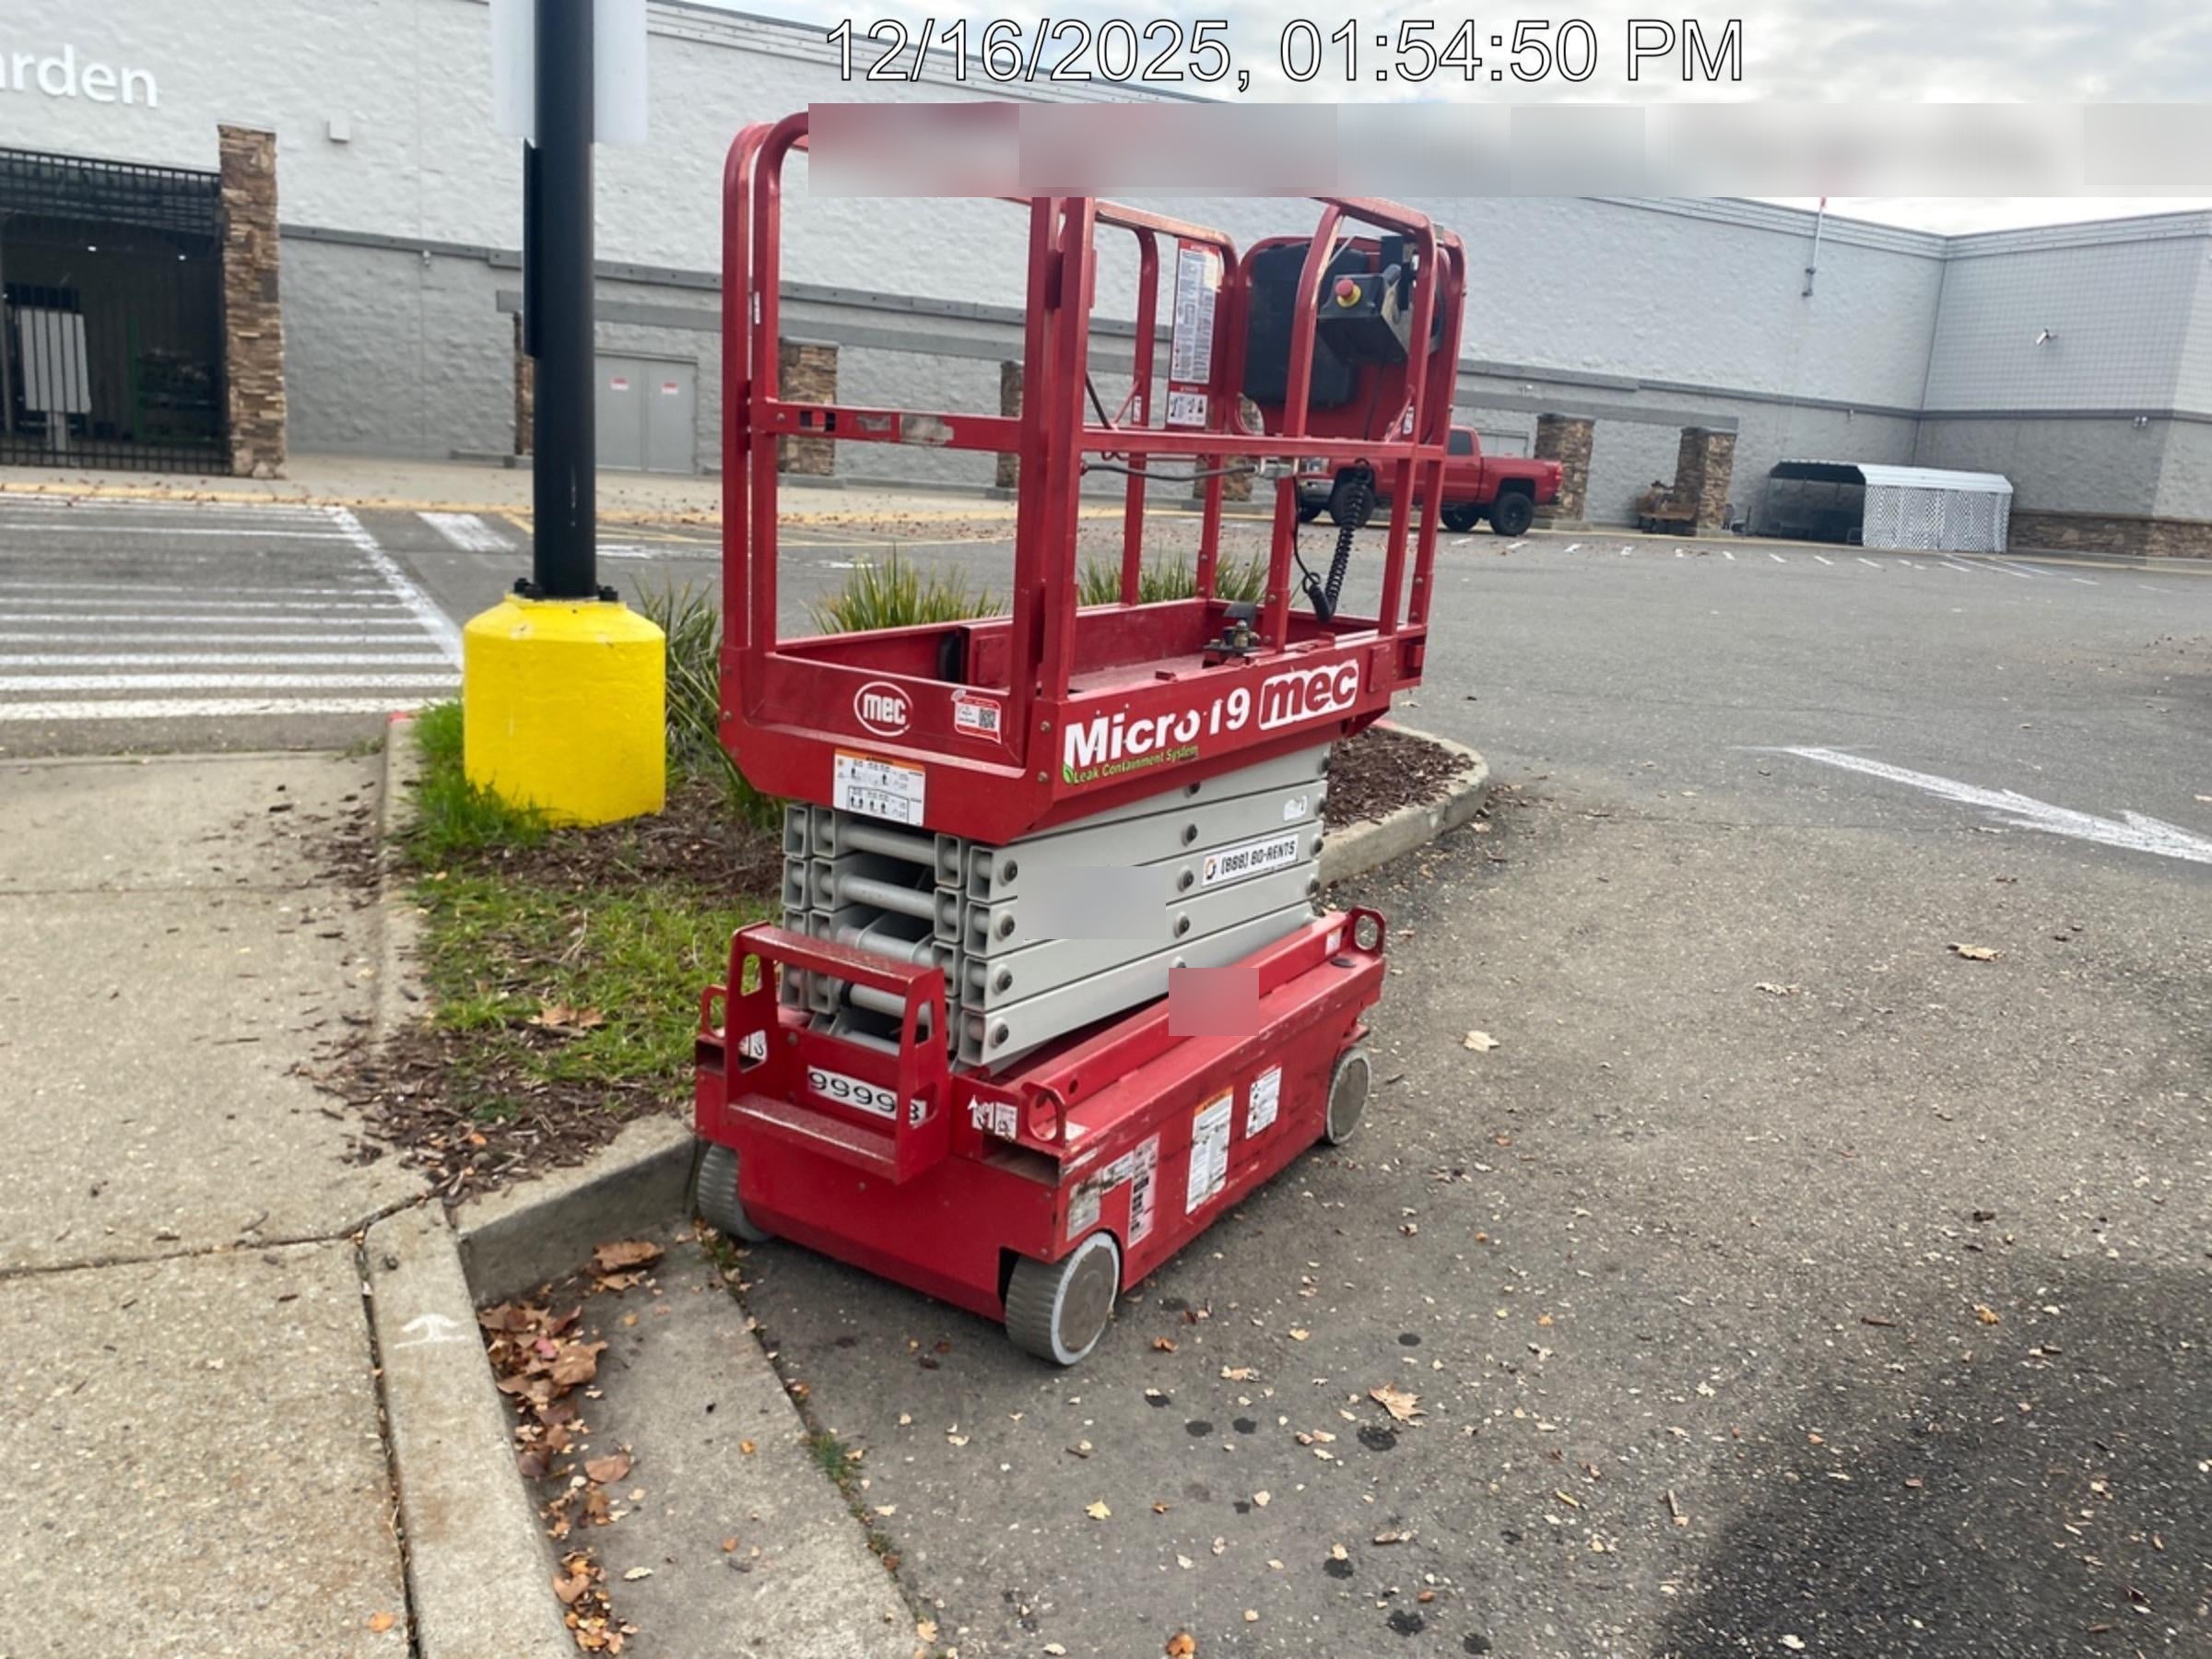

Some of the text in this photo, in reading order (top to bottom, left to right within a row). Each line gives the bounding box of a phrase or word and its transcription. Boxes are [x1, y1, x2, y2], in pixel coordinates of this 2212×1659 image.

[0, 43, 159, 108] rden
[1064, 708, 1200, 768] Micro
[1209, 688, 1251, 735] 19
[1074, 746, 1197, 784] Leak Containment System
